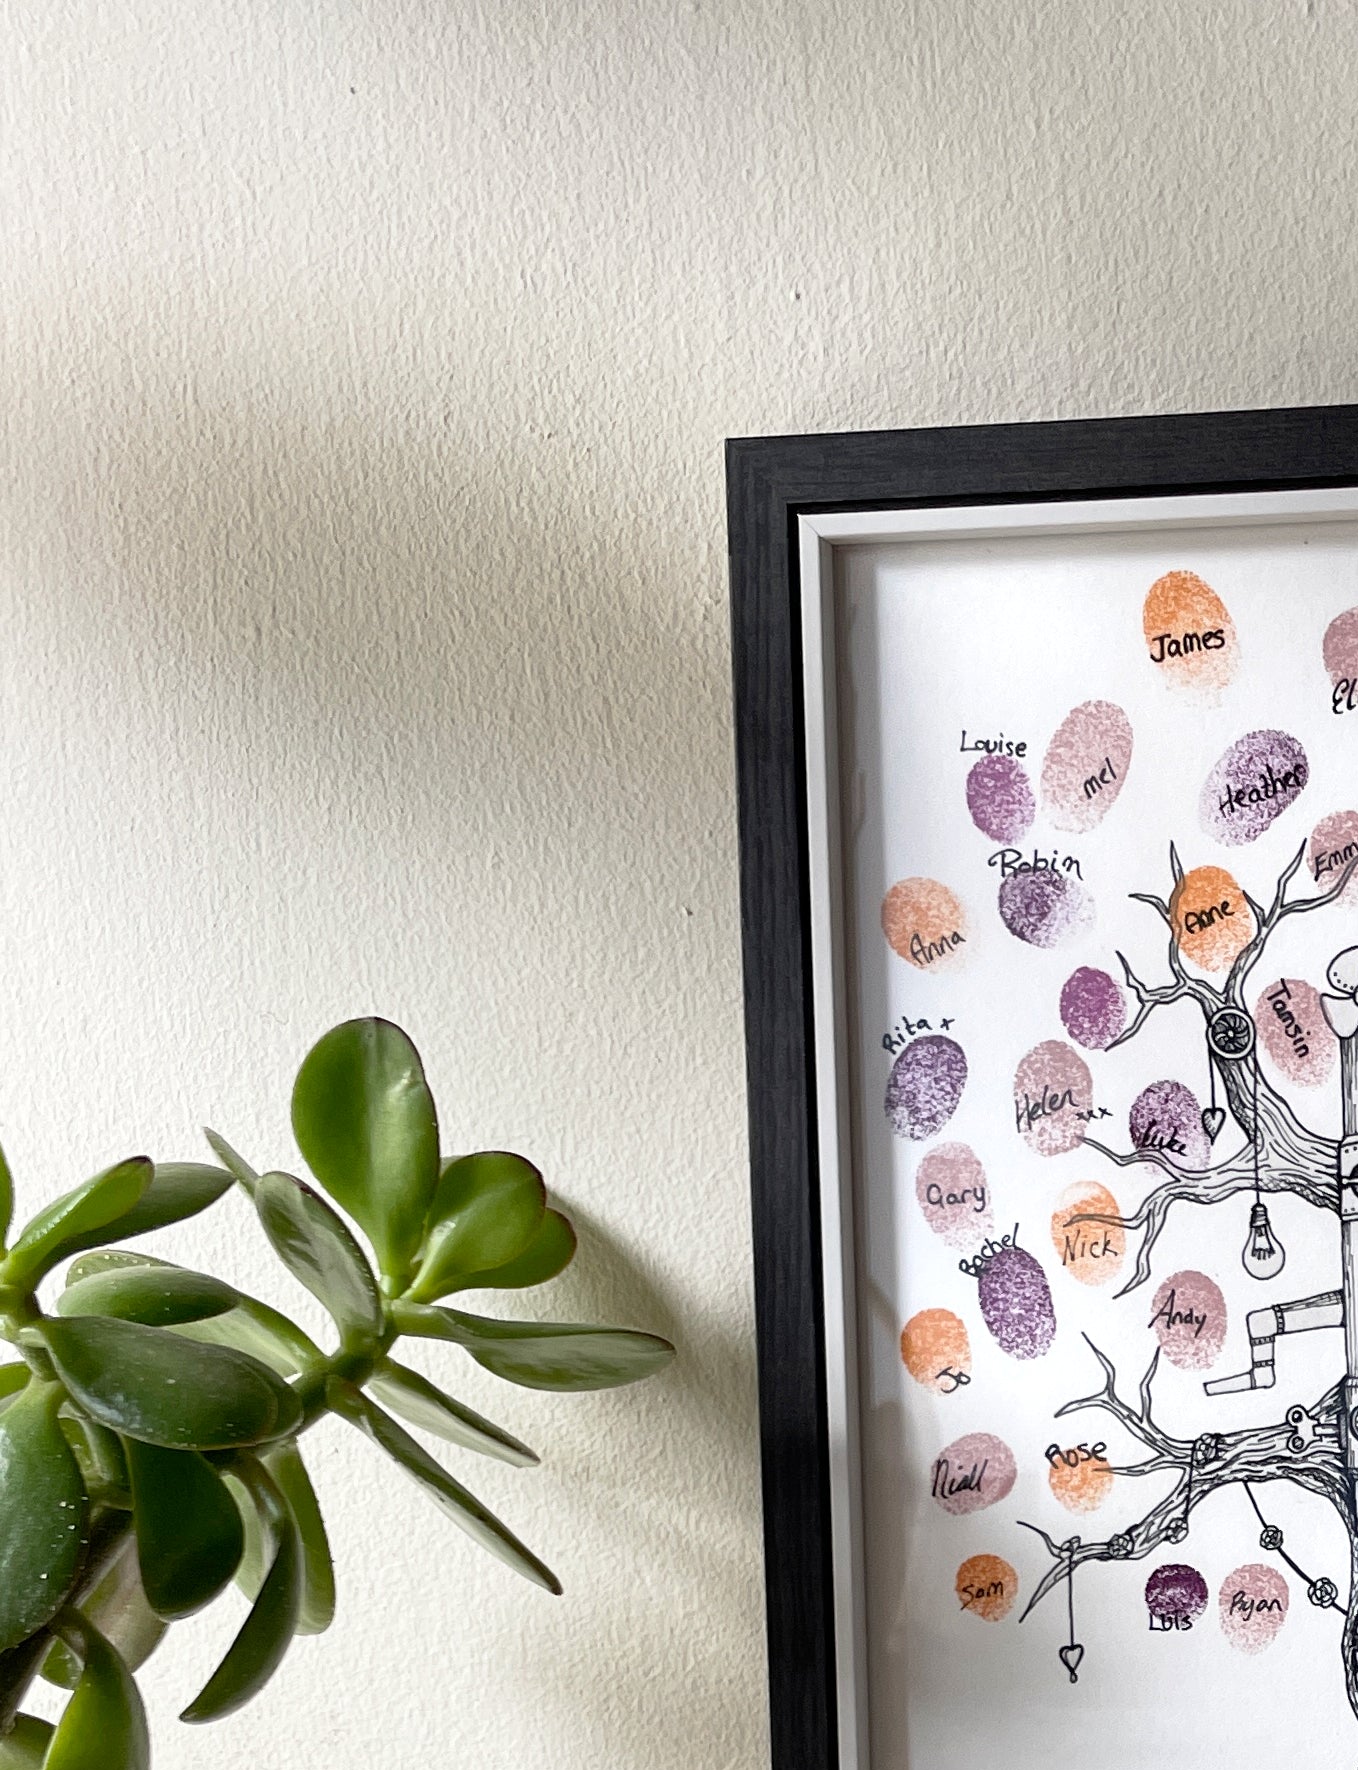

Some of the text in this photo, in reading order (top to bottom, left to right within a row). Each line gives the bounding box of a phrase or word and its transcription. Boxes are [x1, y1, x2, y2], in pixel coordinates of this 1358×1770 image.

[1150, 627, 1226, 663] James
[960, 730, 1028, 757] Louise
[1218, 762, 1307, 817] Heather
[988, 848, 1084, 881] Robin
[909, 932, 967, 965] Anna
[882, 1015, 931, 1055] Rita
[1264, 978, 1310, 1059] Tamsin
[1014, 1084, 1079, 1133] Helen
[926, 1183, 987, 1213] Gary
[1061, 1233, 1119, 1266] Nick
[1147, 1288, 1207, 1338] Andy
[934, 1366, 972, 1394] Jo
[1044, 1441, 1108, 1472] Rose
[1229, 1592, 1283, 1621] Ryan
